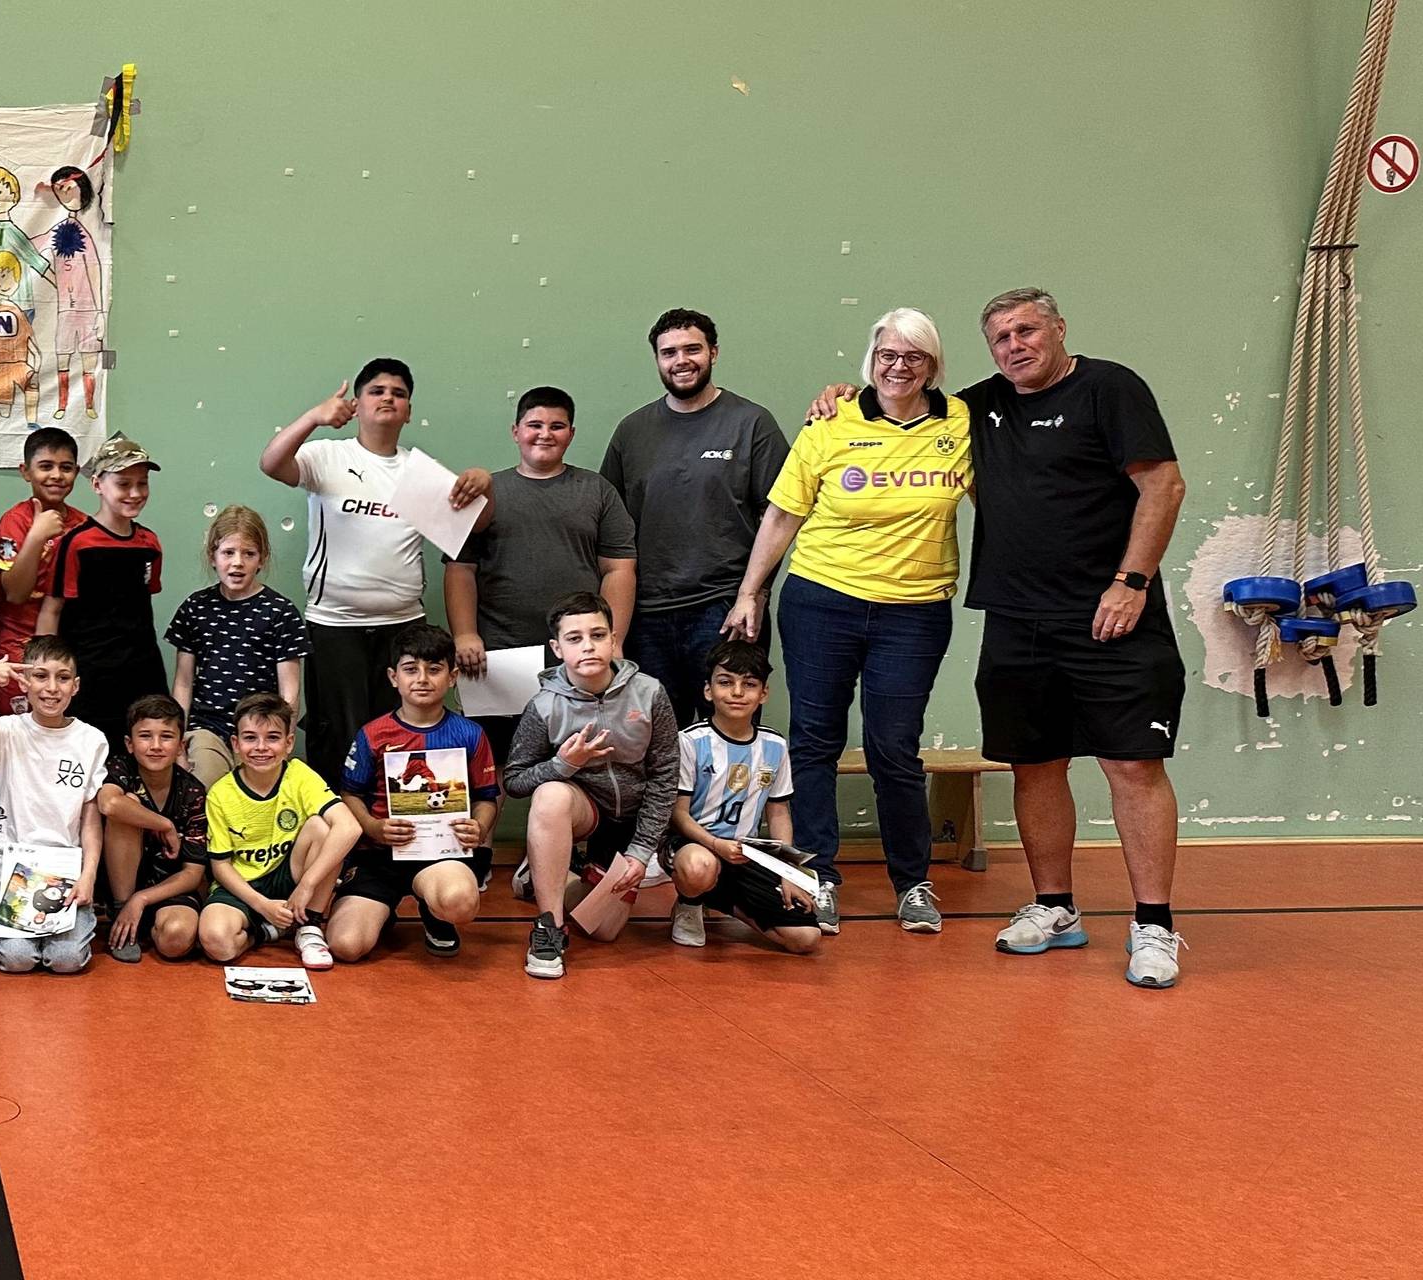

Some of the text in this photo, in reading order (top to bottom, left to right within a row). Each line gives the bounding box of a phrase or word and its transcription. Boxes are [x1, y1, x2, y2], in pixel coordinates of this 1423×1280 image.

[937, 436, 954, 449] BVB
[701, 450, 723, 459] AOK
[872, 470, 966, 490] EVONIK
[342, 499, 399, 518] CHEC
[717, 801, 744, 825] 10
